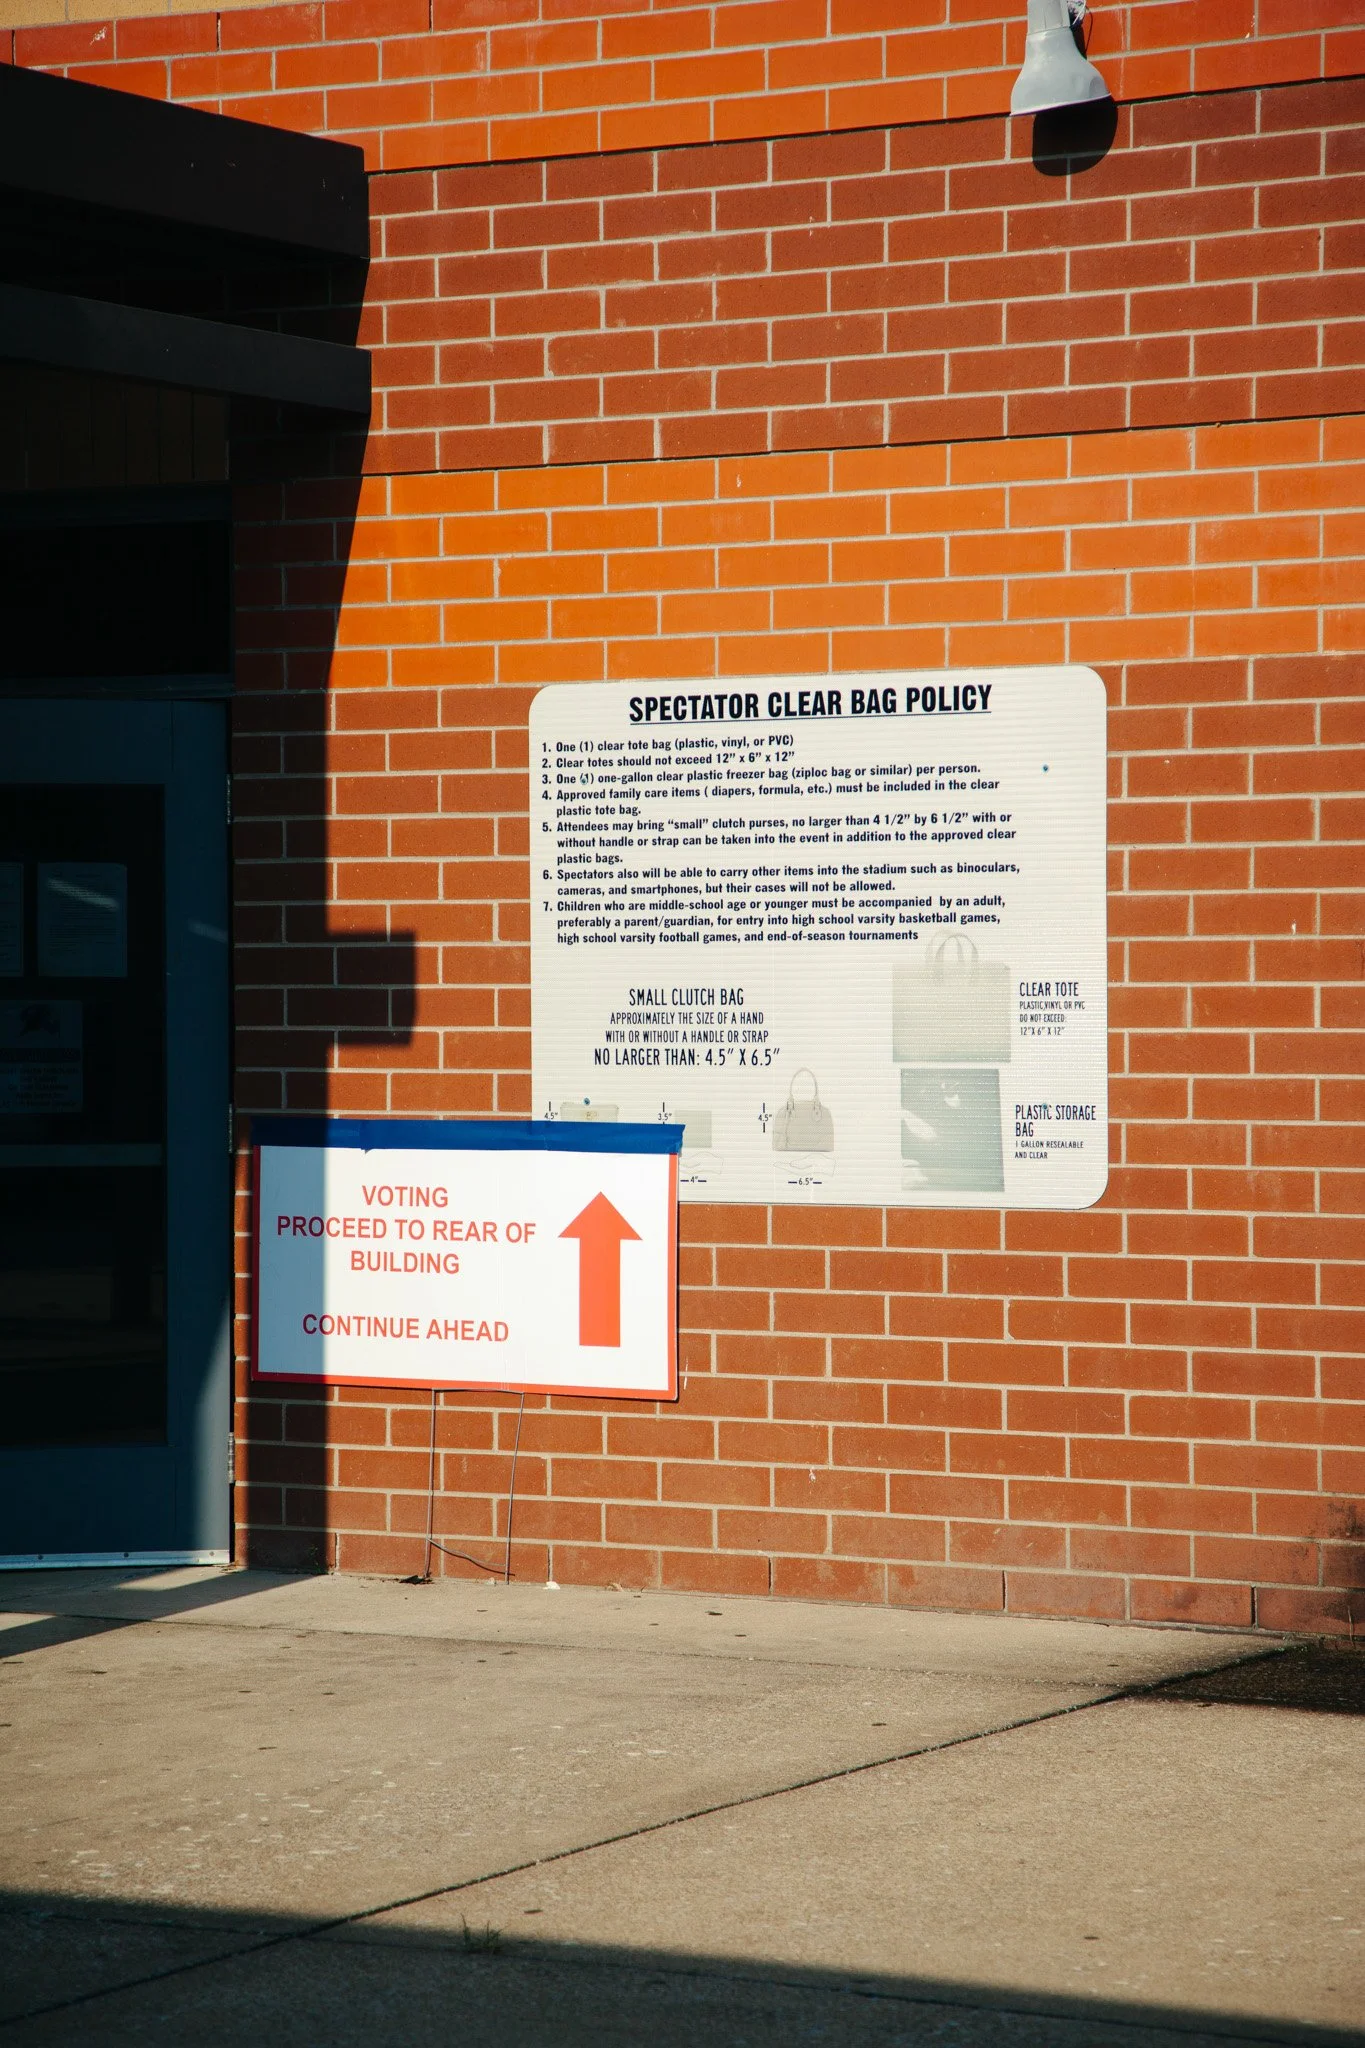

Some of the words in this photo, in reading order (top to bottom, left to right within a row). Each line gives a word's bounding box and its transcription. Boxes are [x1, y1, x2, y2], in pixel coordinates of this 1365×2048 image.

[628, 692, 759, 722] SPECTATOR
[767, 689, 842, 718] CLEAR
[850, 687, 896, 716] BAG
[906, 684, 992, 714] POLICY
[542, 742, 551, 752] 1.
[555, 741, 576, 752] One
[579, 740, 594, 753] (1)
[597, 740, 624, 751] clear
[627, 739, 648, 750] tote
[651, 738, 671, 751] bag
[674, 737, 718, 751] (plastic,
[721, 735, 749, 749] vinyl,
[753, 738, 765, 746] or
[768, 734, 793, 746] PVC)
[541, 773, 551, 784] 3.
[556, 773, 576, 784] One
[597, 771, 653, 785] one-gallon
[656, 770, 683, 781] clear
[686, 769, 723, 783] plastic
[726, 768, 765, 779] freezer
[768, 767, 788, 780] bag
[791, 766, 827, 780] (ziploc
[831, 766, 851, 779] bag
[854, 768, 866, 776] or
[869, 763, 912, 776] similar)
[916, 766, 935, 777] per
[938, 764, 980, 776] person.
[556, 804, 591, 818] plastic
[594, 805, 615, 815] tote
[619, 804, 641, 816] bag.
[556, 836, 596, 848] without
[598, 835, 634, 847] handle
[637, 838, 648, 846] or
[651, 835, 679, 848] strap
[682, 837, 701, 845] can
[704, 834, 718, 845] be
[720, 833, 751, 845] taken
[754, 833, 775, 844] into
[778, 832, 796, 843] the
[799, 832, 829, 843] event
[832, 831, 843, 842] in
[846, 830, 891, 842] addition
[894, 831, 906, 841] to
[909, 829, 927, 841] the
[930, 828, 983, 843] approved
[986, 827, 1016, 839] clear
[542, 869, 552, 880] 6.
[556, 869, 614, 882] Spectators
[617, 868, 638, 879] also
[642, 867, 660, 878] will
[663, 867, 676, 878] be
[680, 866, 702, 877] able
[705, 867, 716, 877] to
[719, 868, 748, 879] carry
[751, 865, 780, 876] other
[784, 865, 814, 876] items
[817, 864, 838, 875] into
[841, 864, 859, 875] the
[862, 863, 906, 874] stadium
[910, 862, 936, 874] such
[940, 865, 953, 873] as
[956, 861, 1020, 874] binoculars,
[557, 887, 604, 896] cameras,
[608, 883, 627, 895] and
[630, 883, 702, 896] smartphones,
[705, 882, 722, 893] but
[725, 882, 752, 893] their
[754, 884, 786, 892] cases
[789, 881, 808, 892] will
[812, 881, 829, 892] not
[832, 880, 846, 891] be
[849, 879, 895, 891] allowed.
[542, 901, 552, 911] 7.
[557, 900, 600, 911] Children
[603, 900, 625, 911] who
[628, 902, 645, 910] are
[648, 898, 723, 910] middle-school
[726, 901, 746, 911] age
[749, 901, 761, 909] or
[764, 900, 808, 911] younger
[811, 897, 838, 908] must
[841, 897, 855, 908] be
[858, 895, 932, 909] accompanied
[939, 895, 952, 908] by
[955, 898, 969, 906] an
[972, 894, 1005, 907] adult,
[557, 932, 579, 945] high
[582, 932, 616, 943] school
[619, 931, 656, 944] varsity
[658, 931, 699, 942] football
[702, 933, 740, 944] games,
[744, 930, 764, 941] and
[766, 929, 845, 941] end-of-season
[848, 929, 918, 940] tournaments
[628, 988, 667, 1006] SMALL
[671, 988, 714, 1006] CLUTCH
[720, 987, 744, 1006] BAG
[1019, 982, 1051, 996] CLEAR
[1055, 982, 1079, 996] TOTE
[1064, 1001, 1073, 1009] OR
[1074, 1001, 1085, 1009] PVC
[610, 1011, 675, 1024] APPROXIMATELY
[678, 1011, 693, 1024] THE
[696, 1011, 714, 1024] SIZE
[717, 1011, 728, 1024] OF
[730, 1011, 736, 1024] A
[740, 1011, 764, 1024] HAND
[605, 1030, 624, 1042] WITH
[628, 1030, 640, 1043] OR
[642, 1029, 679, 1043] WITHOUT
[681, 1030, 688, 1043] A
[690, 1030, 724, 1043] HANDLE
[727, 1029, 738, 1043] OR
[742, 1030, 768, 1043] STRAP
[594, 1047, 610, 1065] NO
[615, 1047, 660, 1065] LARGER
[664, 1048, 700, 1066] THAN:
[739, 1048, 746, 1065] X
[1015, 1104, 1052, 1120] PLASTIC
[1055, 1105, 1097, 1120] STORAGE
[1015, 1122, 1034, 1137] BAG
[1021, 1140, 1044, 1148] GALLON
[1046, 1141, 1084, 1149] RESEALABLE
[1015, 1151, 1027, 1159] AND
[1029, 1151, 1048, 1159] CLEAR
[361, 1184, 449, 1208] VOTING
[277, 1215, 387, 1239] PROCEED
[395, 1218, 425, 1240] TO
[433, 1219, 499, 1242] REAR
[505, 1222, 537, 1244] OF
[350, 1250, 460, 1274] BUILDING
[302, 1313, 420, 1339] CONTINUE
[426, 1318, 510, 1342] AHEAD
